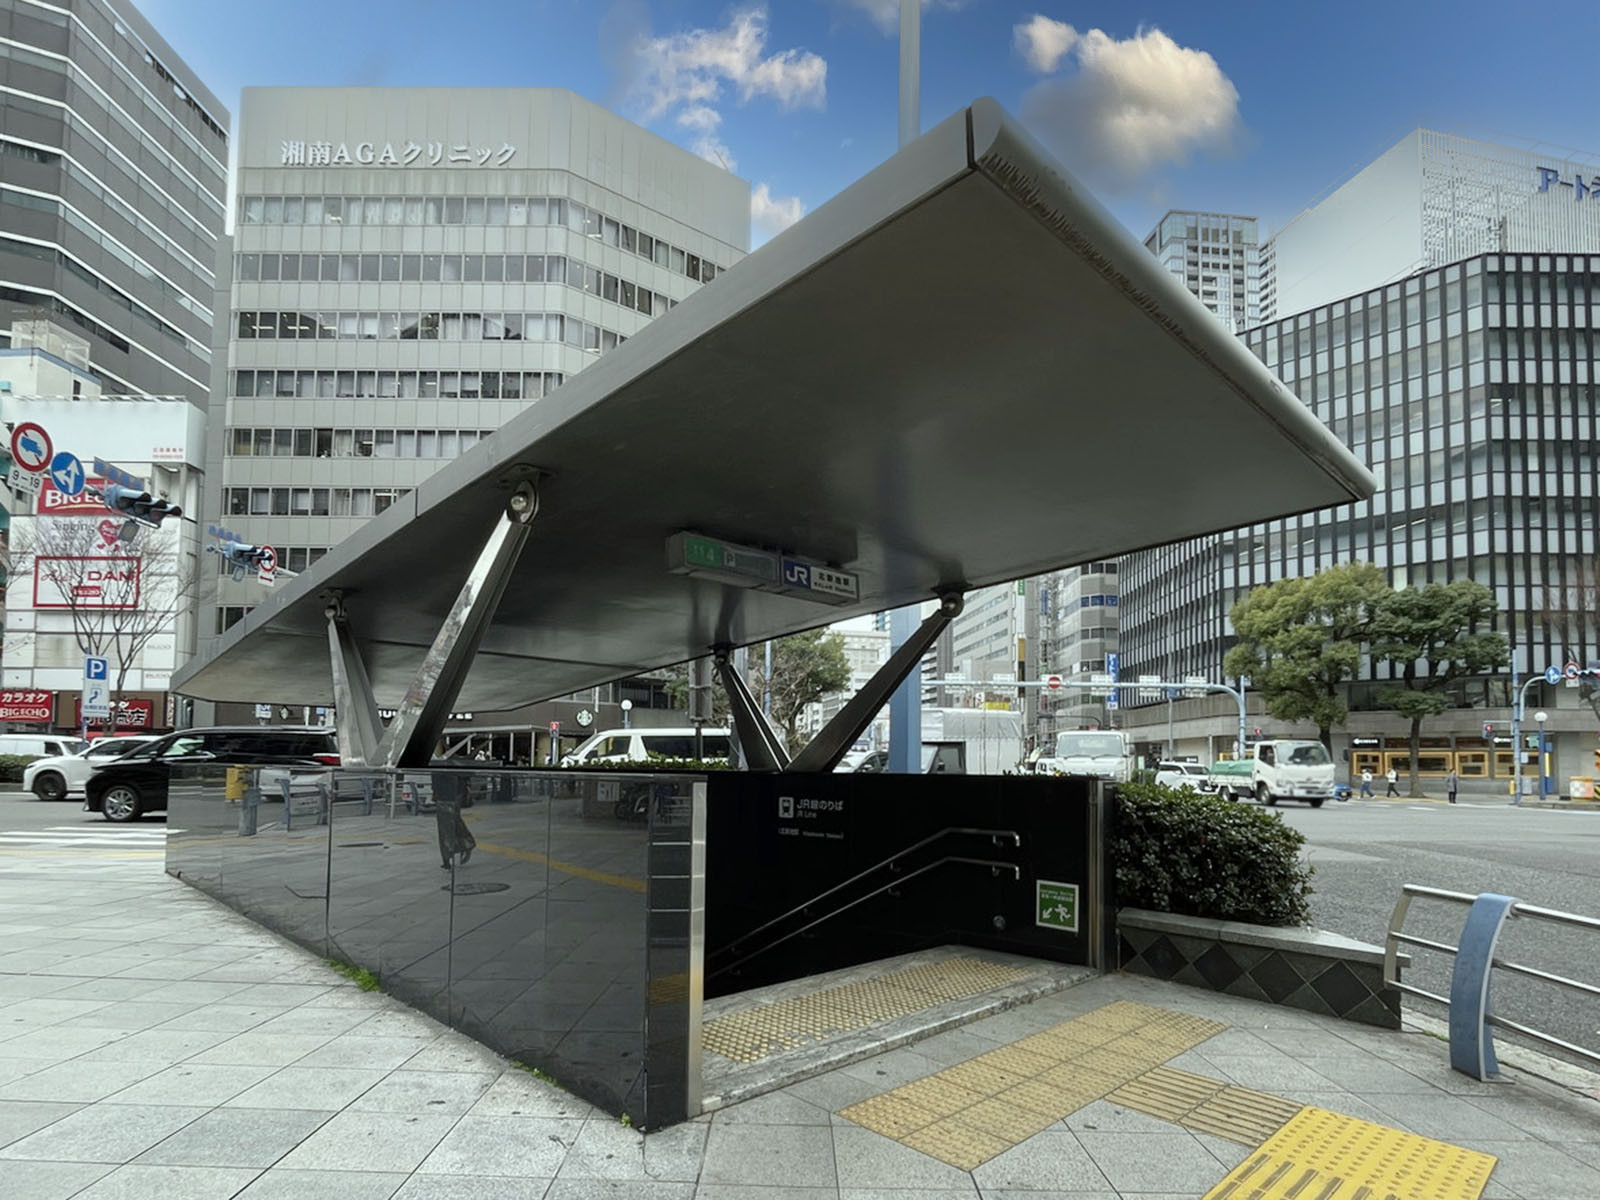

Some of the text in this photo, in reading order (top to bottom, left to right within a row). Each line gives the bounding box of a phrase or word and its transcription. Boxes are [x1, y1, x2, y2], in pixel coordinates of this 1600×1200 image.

[280, 139, 517, 167] 湘南AGAクリニック
[786, 566, 809, 585] JR
[1, 692, 49, 704] カラオケ
[0, 708, 50, 718] BIG ECHO
